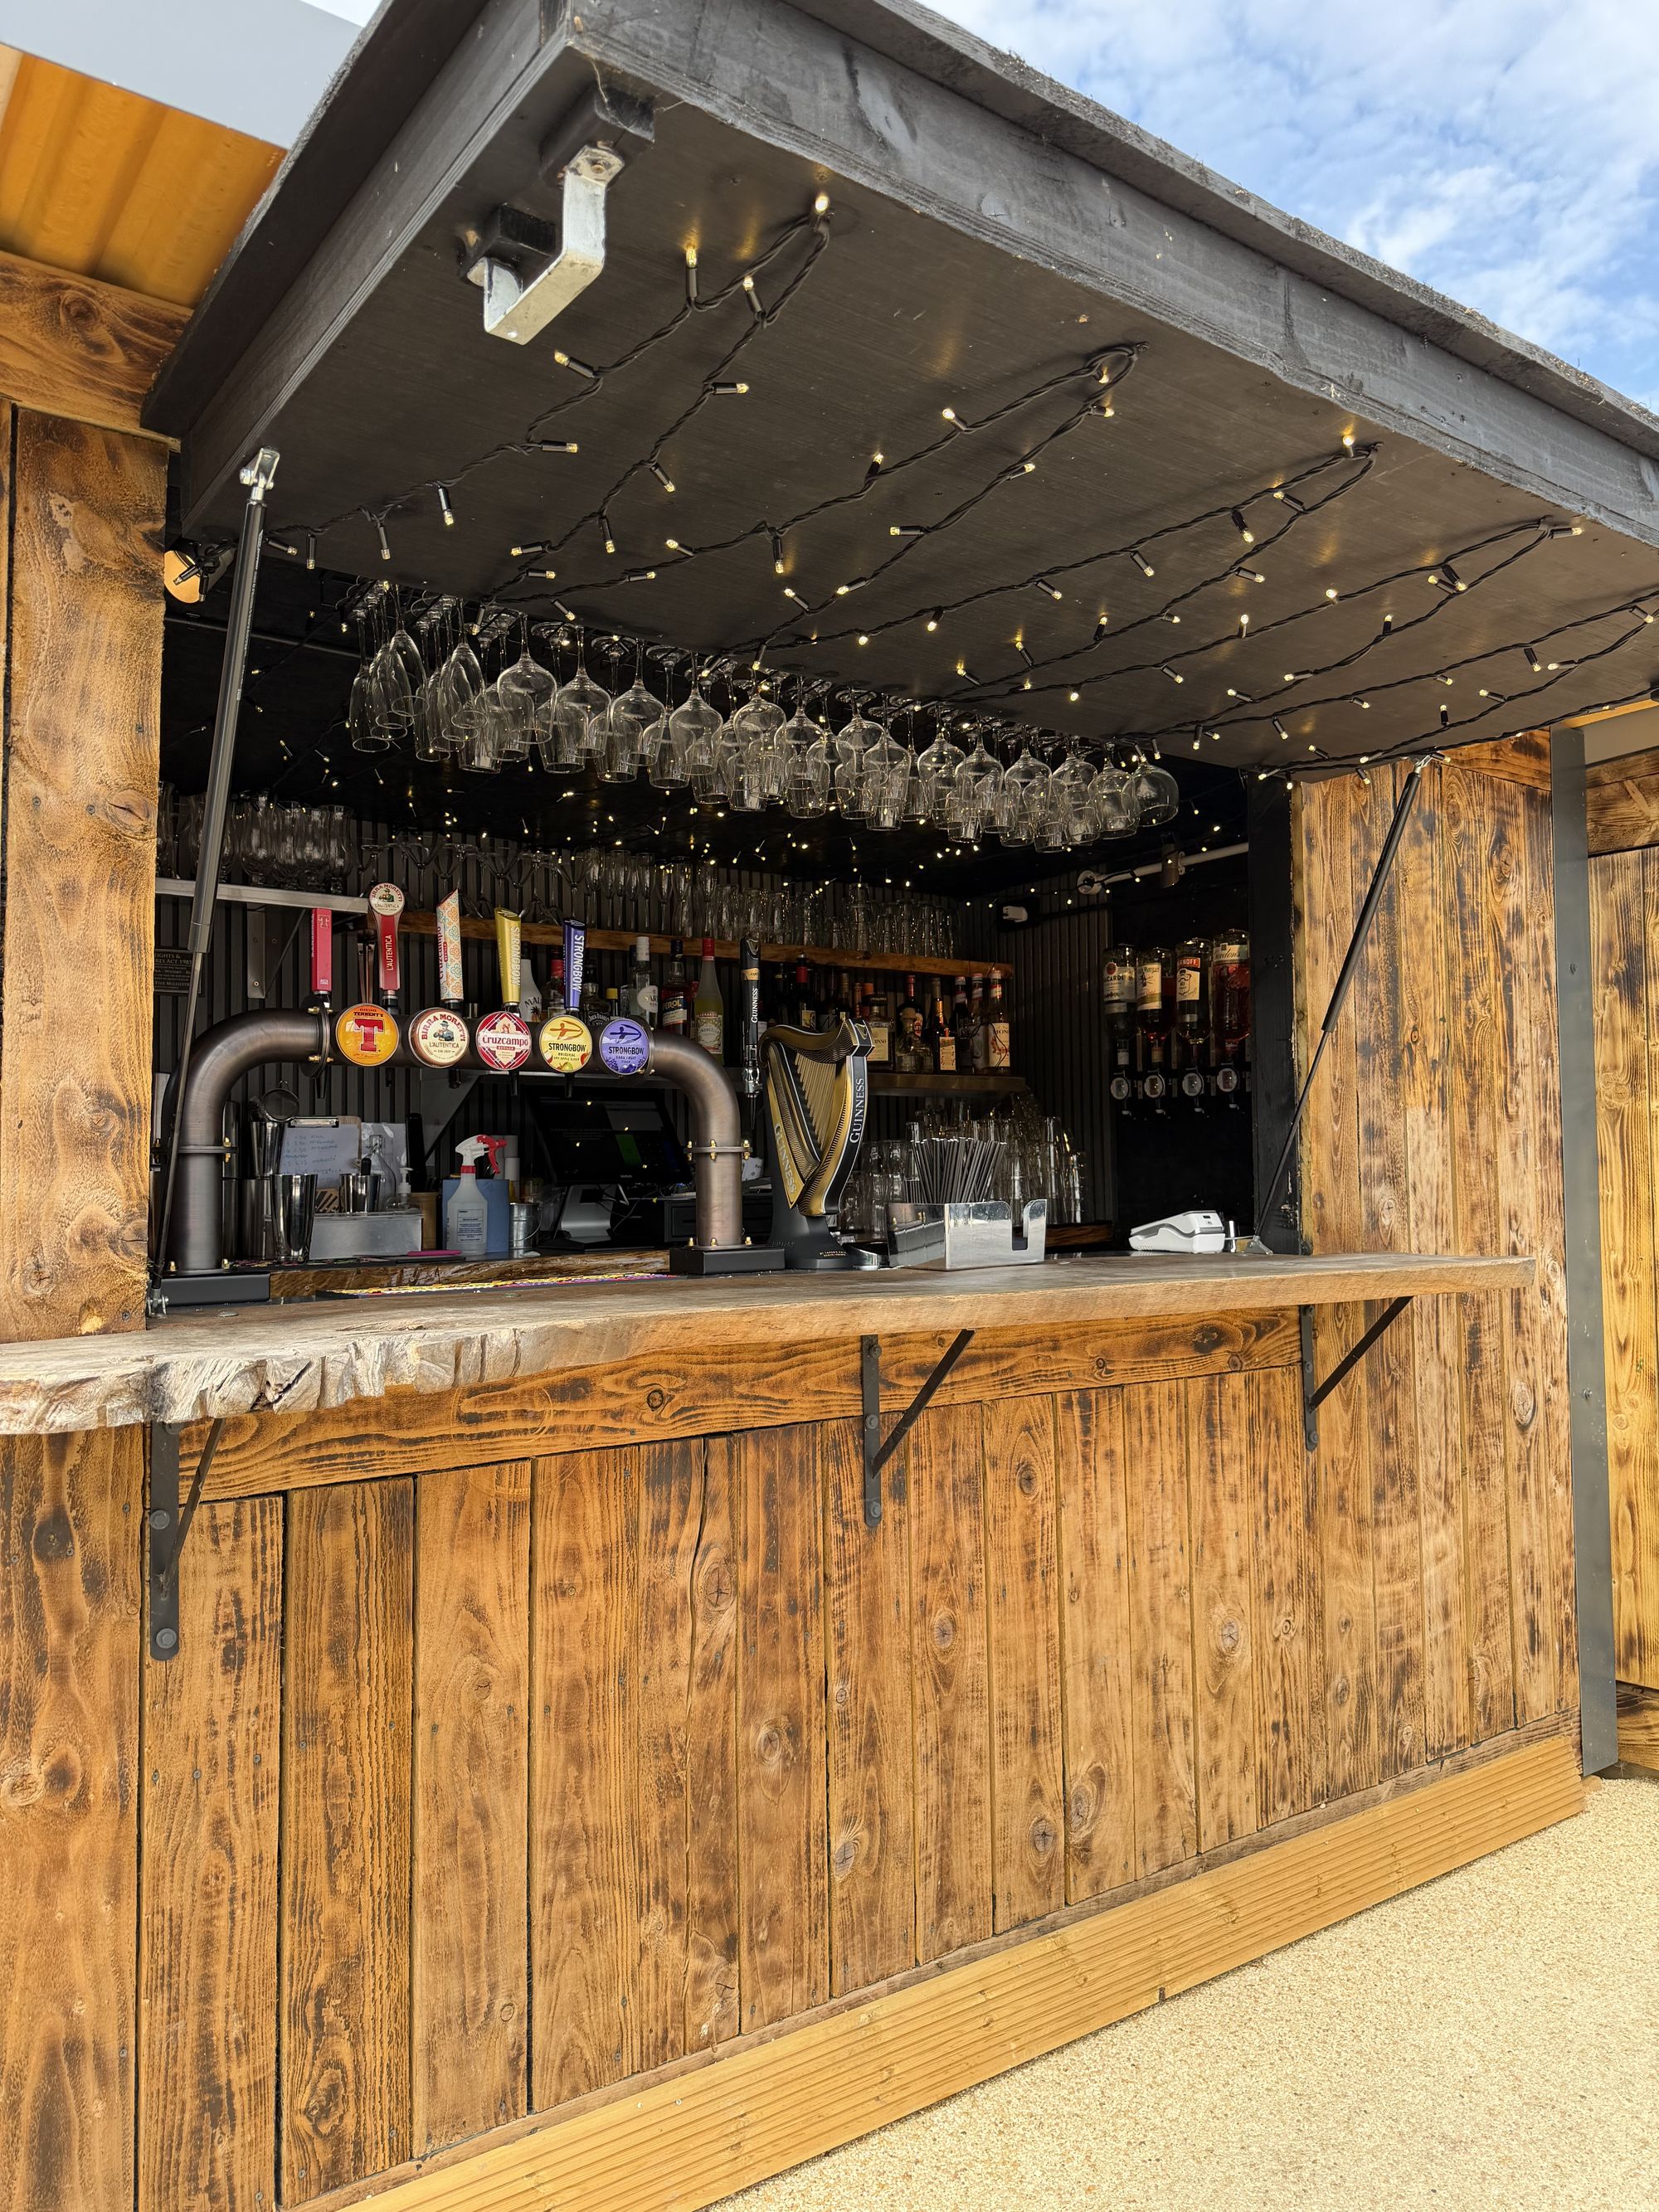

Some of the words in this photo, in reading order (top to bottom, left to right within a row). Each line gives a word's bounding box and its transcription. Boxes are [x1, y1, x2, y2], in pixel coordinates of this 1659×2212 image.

[385, 935, 394, 970] L'AUTENTICA
[510, 926, 520, 987] STRONGBOW
[572, 935, 585, 994] STRONGBOW
[354, 1018, 384, 1053] T
[421, 1015, 439, 1040] BIRRA
[440, 1014, 466, 1042] MORETTI
[482, 1035, 528, 1047] Cruzcampo
[548, 1043, 586, 1052] STRONGBOW
[608, 1046, 645, 1055] STRONGBOW
[849, 1078, 864, 1144] GUINNESS
[774, 1124, 796, 1194] GUINNESS
